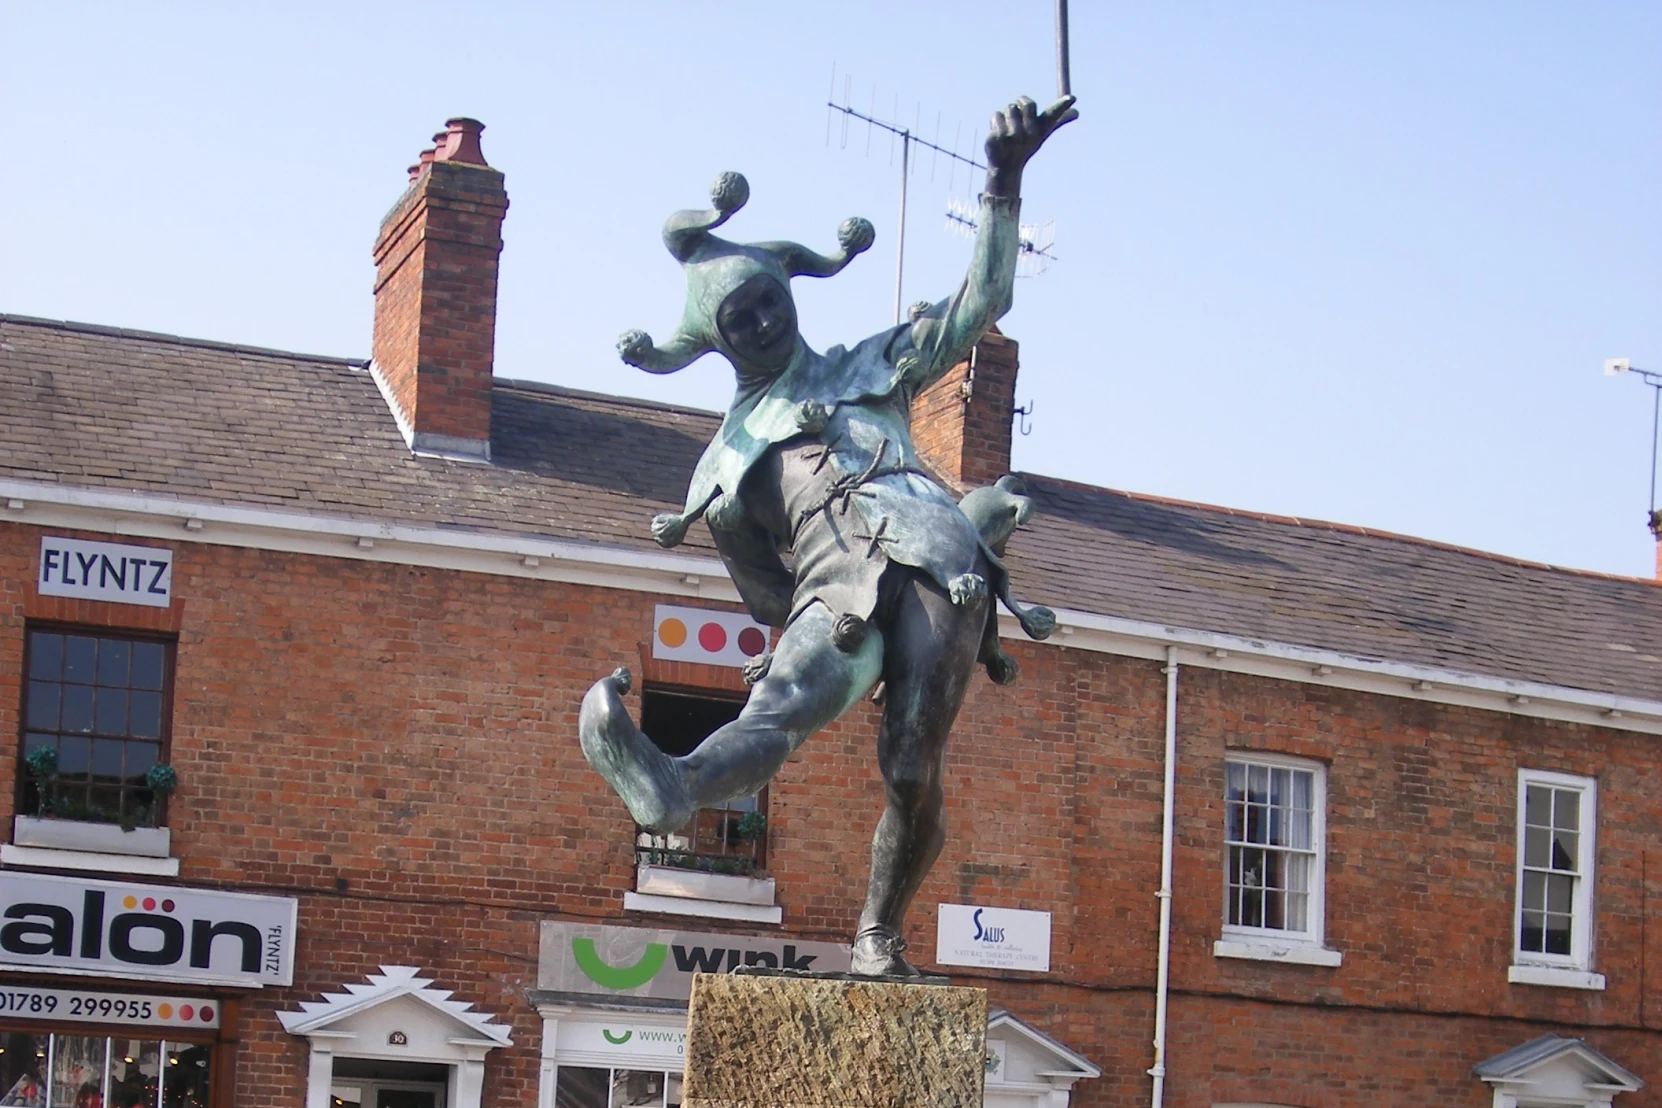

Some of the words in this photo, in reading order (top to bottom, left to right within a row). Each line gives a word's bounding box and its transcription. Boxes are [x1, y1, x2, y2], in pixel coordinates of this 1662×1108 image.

[43, 549, 168, 594] FLYNTZ
[70, 997, 152, 1019] 299955
[393, 1034, 404, 1044] 30
